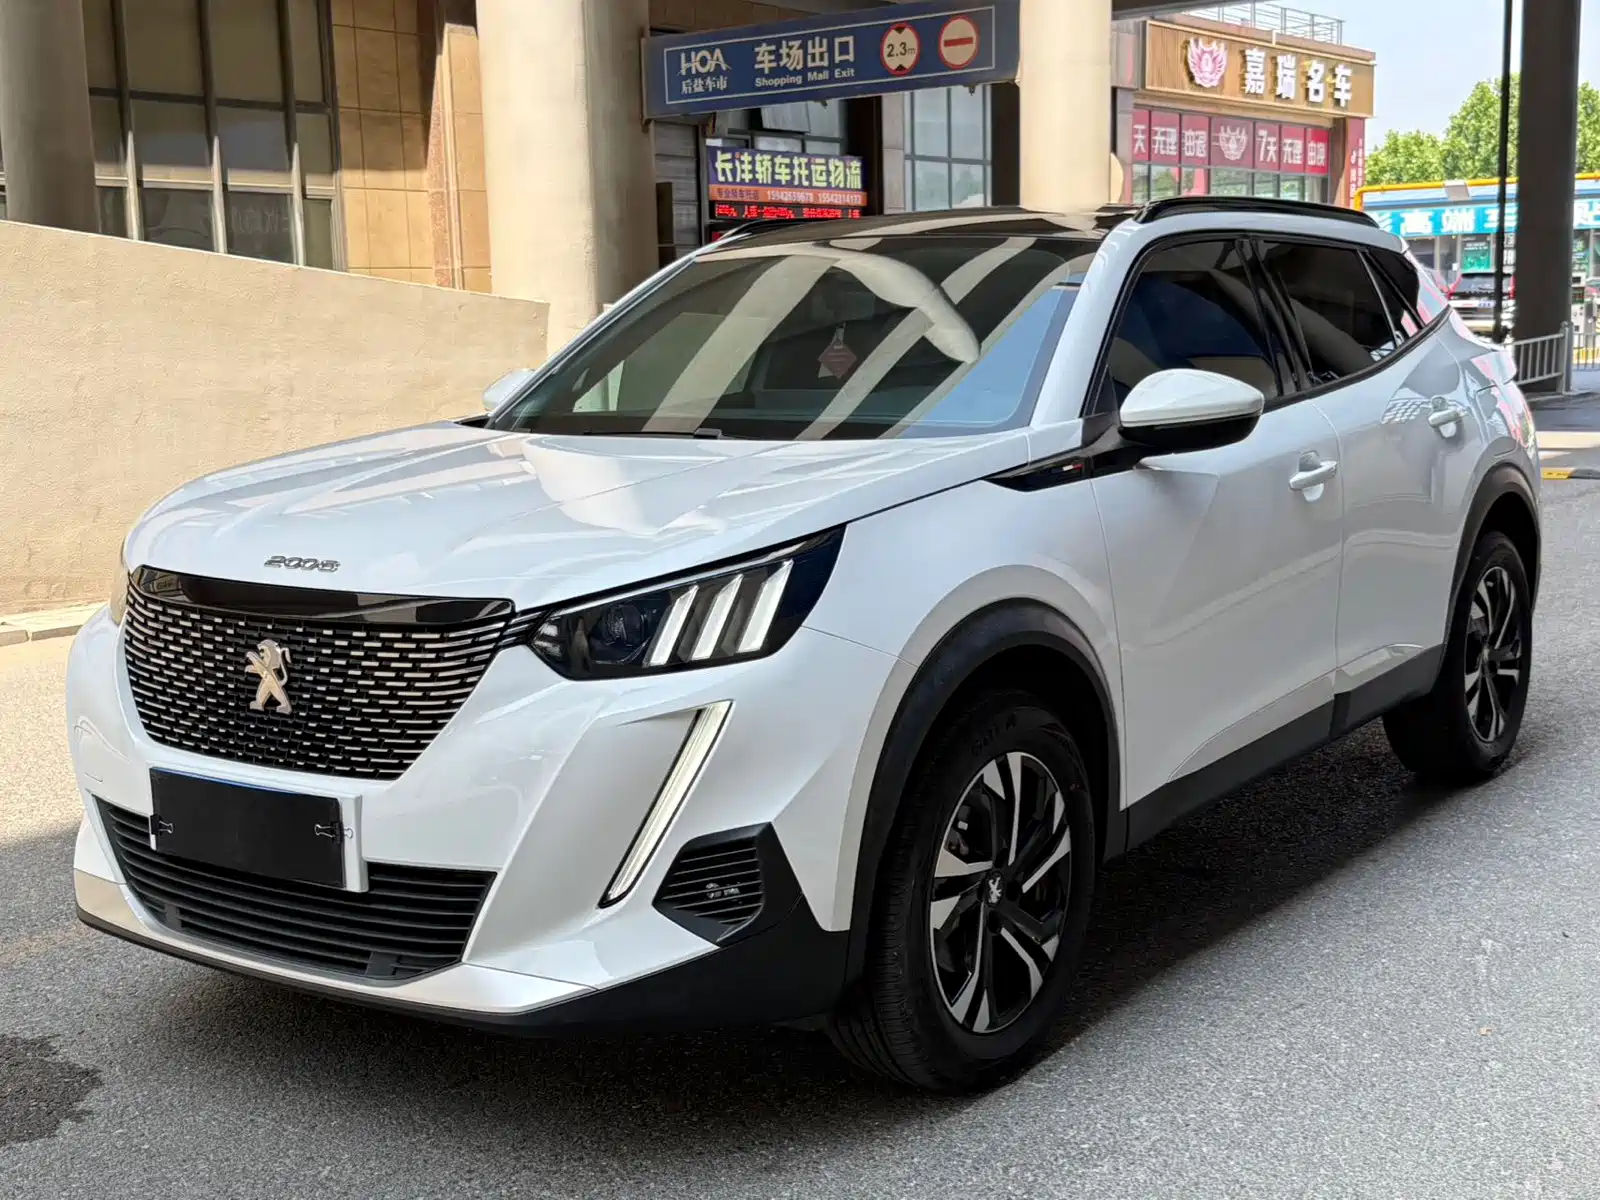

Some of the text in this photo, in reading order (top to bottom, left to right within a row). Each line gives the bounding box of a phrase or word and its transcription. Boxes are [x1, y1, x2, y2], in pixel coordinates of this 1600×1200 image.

[679, 48, 728, 75] HOA
[754, 35, 855, 74] 车场出口
[886, 42, 916, 58] 2.3m
[755, 68, 855, 87] Shopping Mall Exit
[1245, 48, 1353, 108] 嘉瑞名车
[264, 555, 340, 573] 2008
